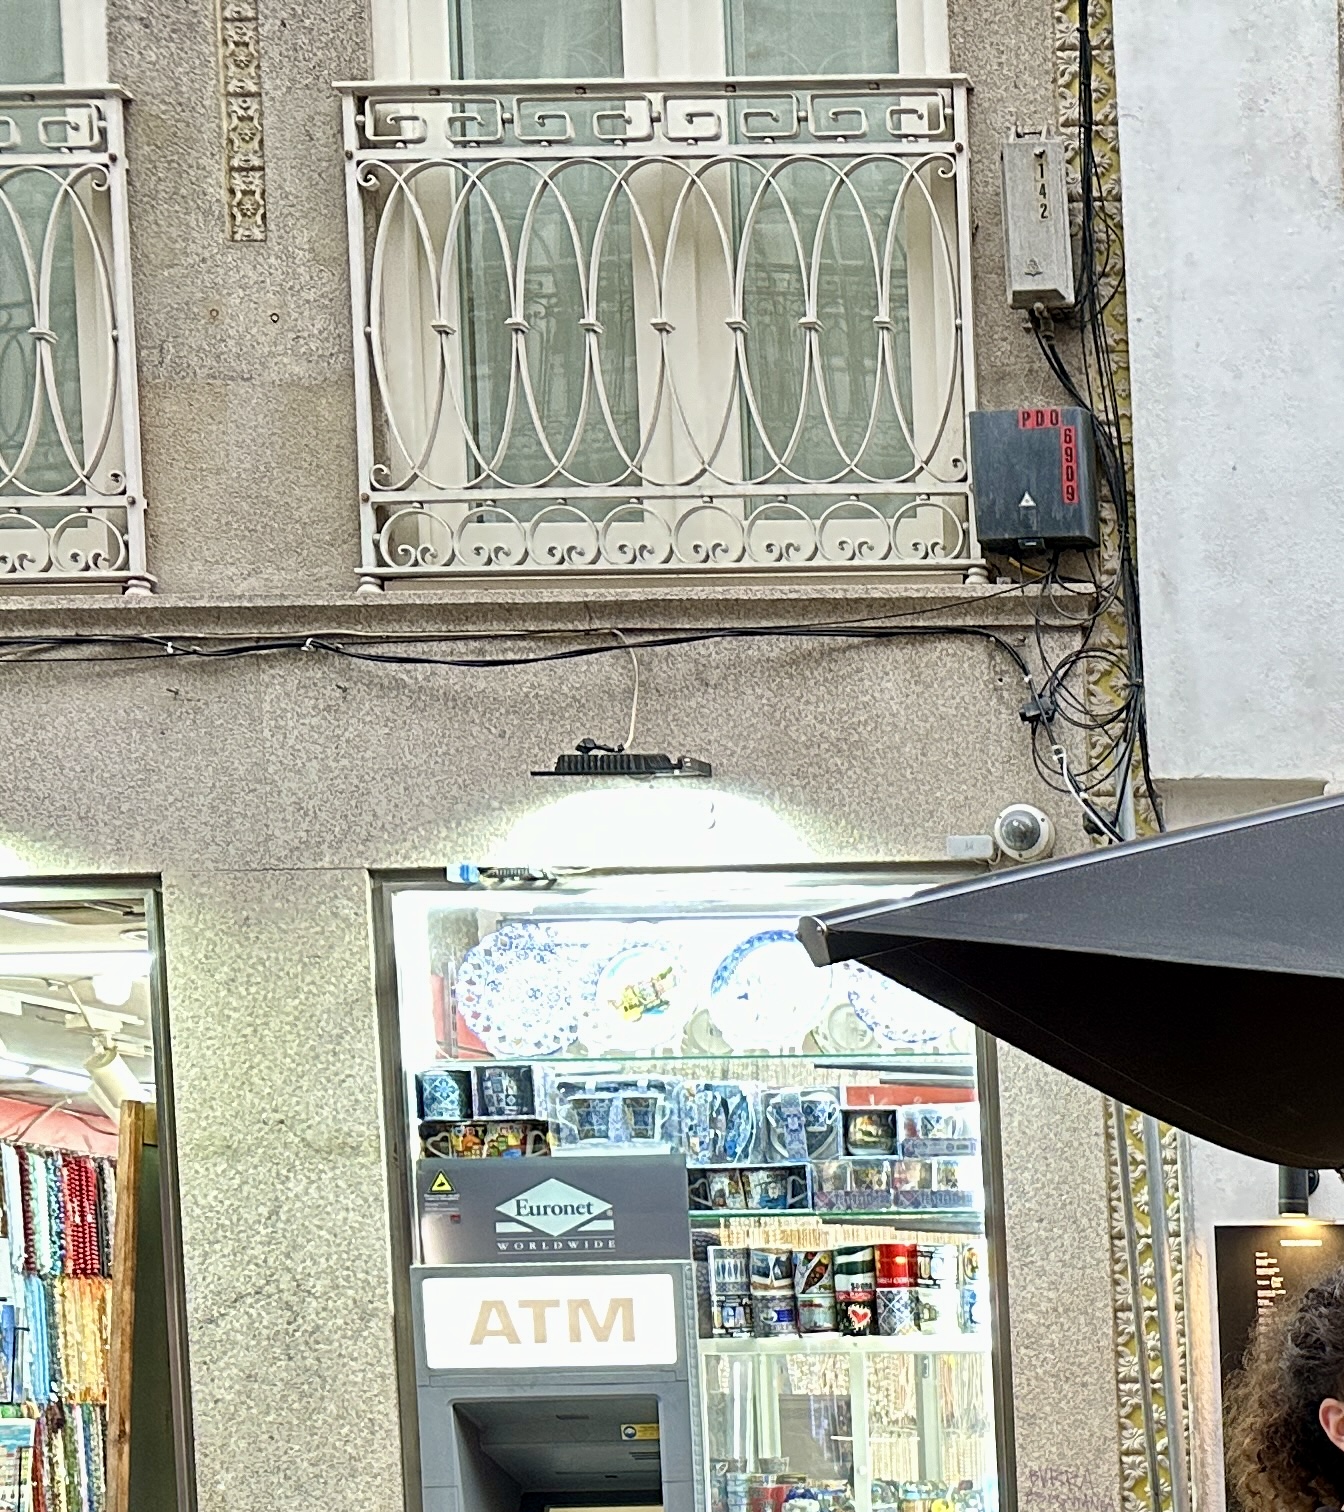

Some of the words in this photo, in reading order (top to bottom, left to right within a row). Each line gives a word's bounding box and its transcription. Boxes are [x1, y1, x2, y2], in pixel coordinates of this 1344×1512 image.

[1039, 164, 1048, 218] 142
[1064, 428, 1074, 501] 6909
[515, 1199, 594, 1217] Euronet
[497, 1239, 616, 1250] WORLDWIDE
[470, 1298, 635, 1345] ATM
